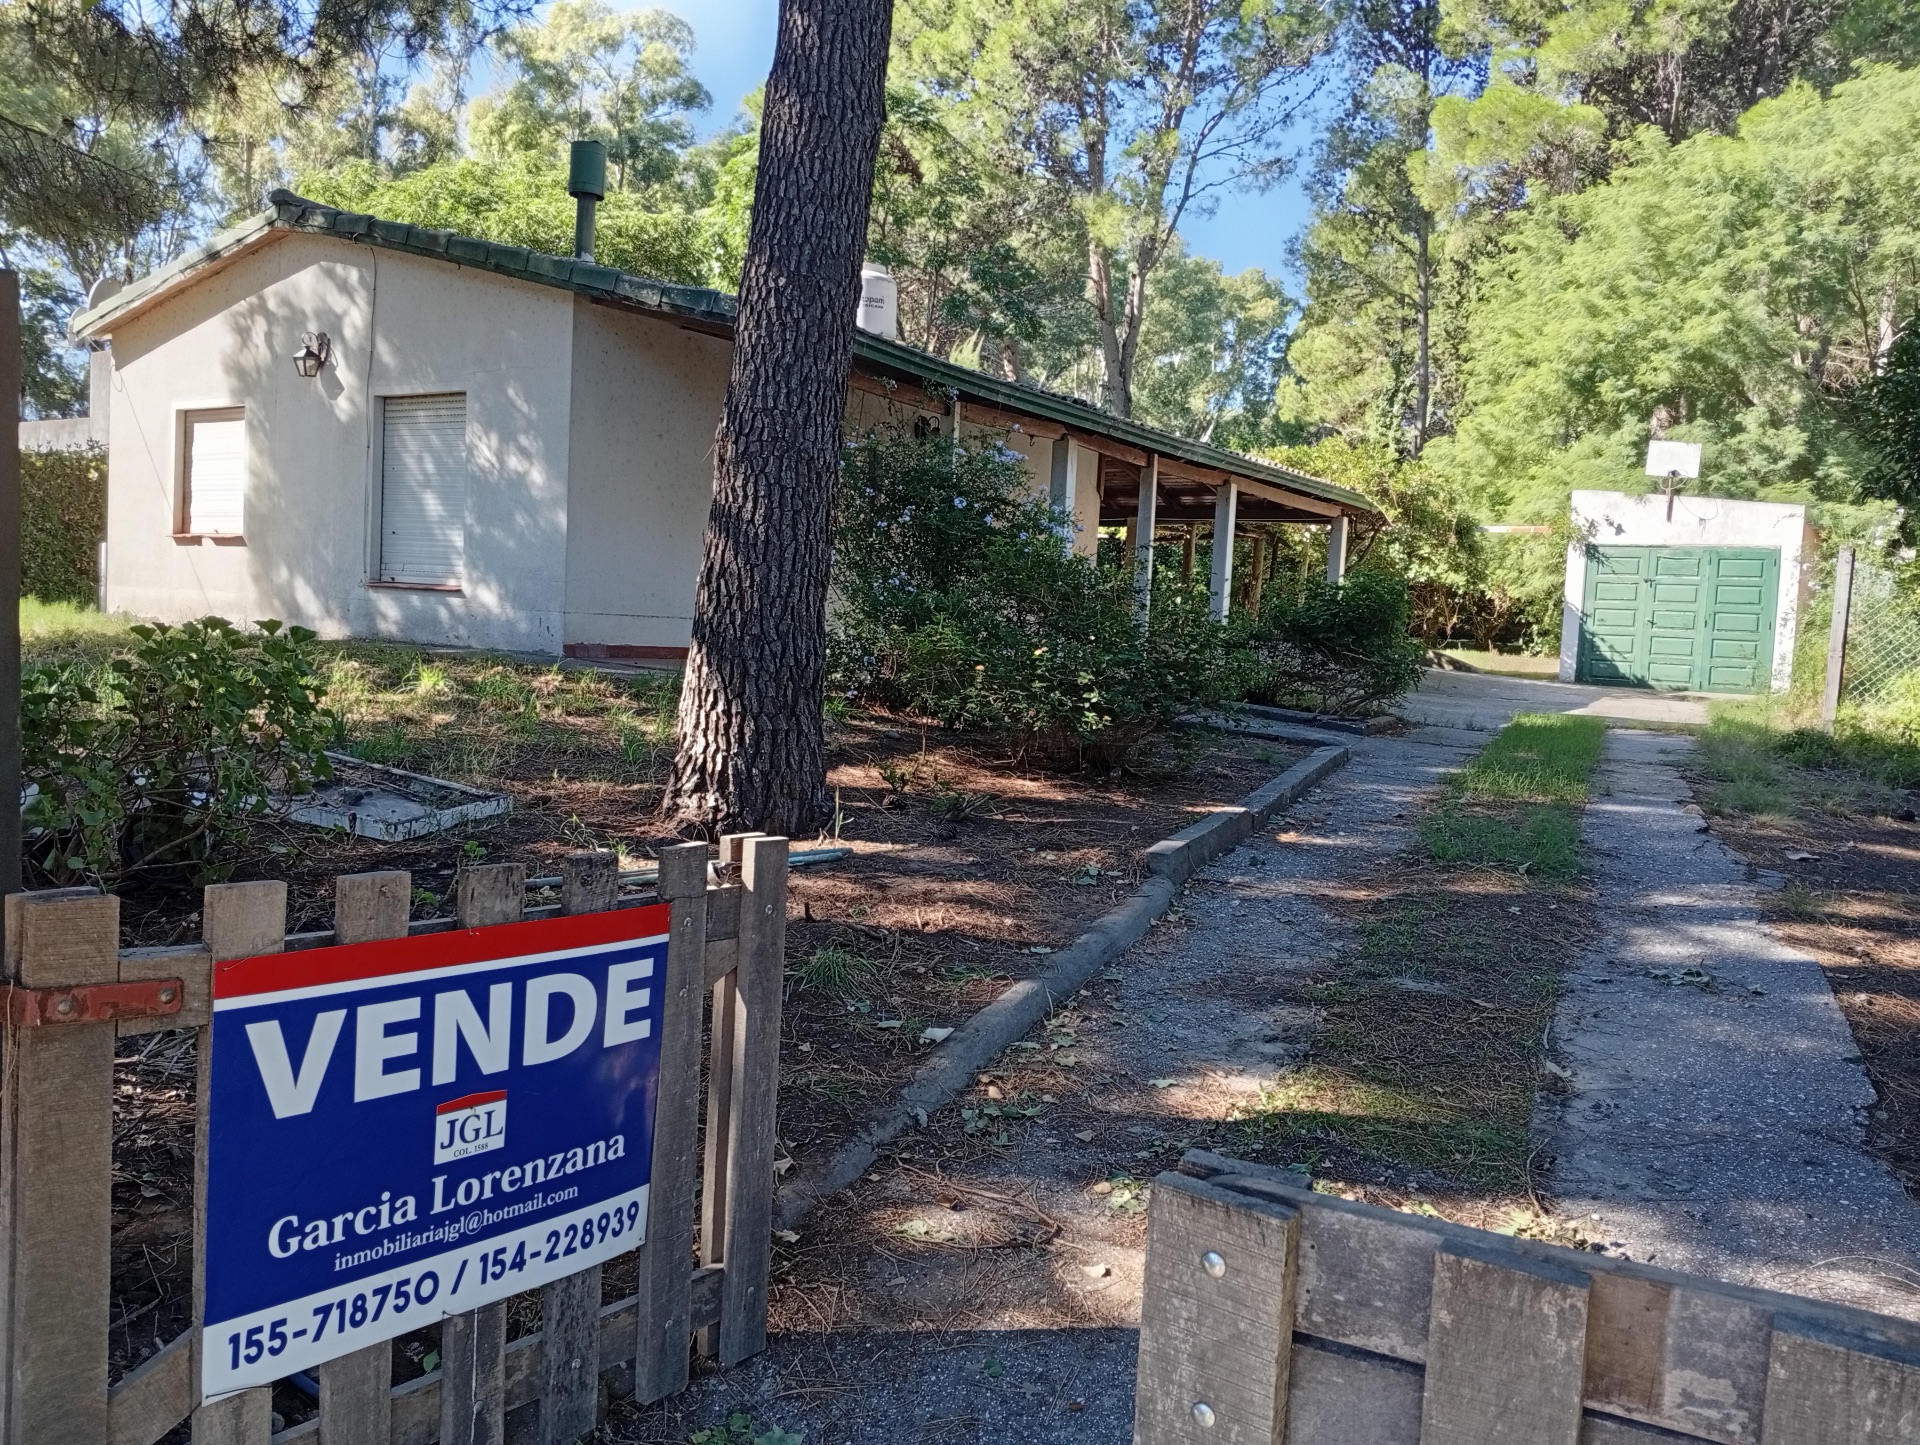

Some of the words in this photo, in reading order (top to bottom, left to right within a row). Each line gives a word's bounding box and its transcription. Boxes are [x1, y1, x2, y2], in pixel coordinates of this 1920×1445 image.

[245, 957, 654, 1120] VENDE
[440, 1109, 504, 1150] JGL
[453, 1147, 472, 1158] COL.
[474, 1142, 489, 1153] 1588
[268, 1191, 417, 1259] Garcia
[430, 1134, 625, 1214] Lorenzana
[333, 1186, 579, 1271] inmobiliariajgl@hotmail.com
[228, 1270, 439, 1370] 155-718750
[480, 1200, 640, 1285] 154-228939
